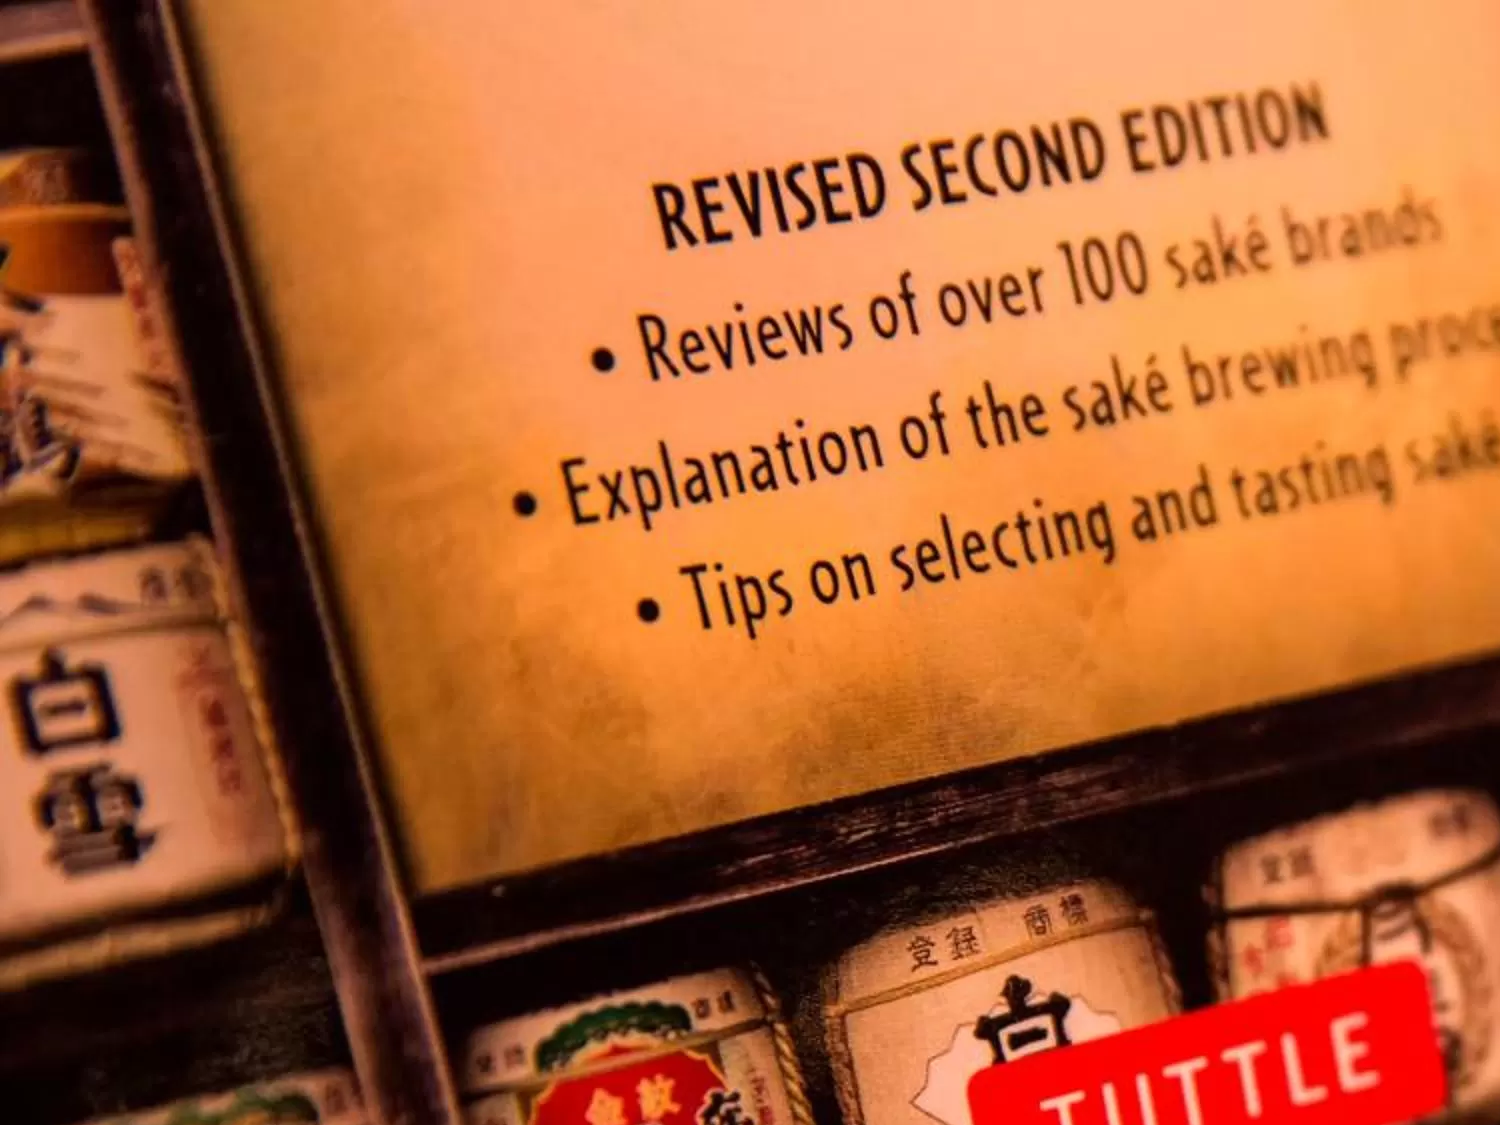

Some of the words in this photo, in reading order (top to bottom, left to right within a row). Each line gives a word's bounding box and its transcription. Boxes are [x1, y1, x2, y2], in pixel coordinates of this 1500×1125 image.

[652, 152, 887, 251] REVISED
[901, 117, 1106, 211] SECOND
[1119, 80, 1331, 174] EDITION
[637, 303, 854, 381] Reviews
[868, 269, 920, 340] of
[937, 266, 1045, 327] over
[1057, 230, 1149, 306] 100
[1163, 213, 1272, 290] saké
[1280, 183, 1445, 268] brands
[561, 418, 884, 532] Explanation
[899, 390, 950, 460] of
[965, 379, 1049, 451] the
[1062, 354, 1174, 432] saké
[1181, 323, 1378, 407] brewing
[680, 561, 794, 639] Tips
[809, 552, 877, 604] on
[890, 499, 1117, 592] selecting
[1130, 462, 1219, 543] and
[1229, 440, 1396, 520] tasting
